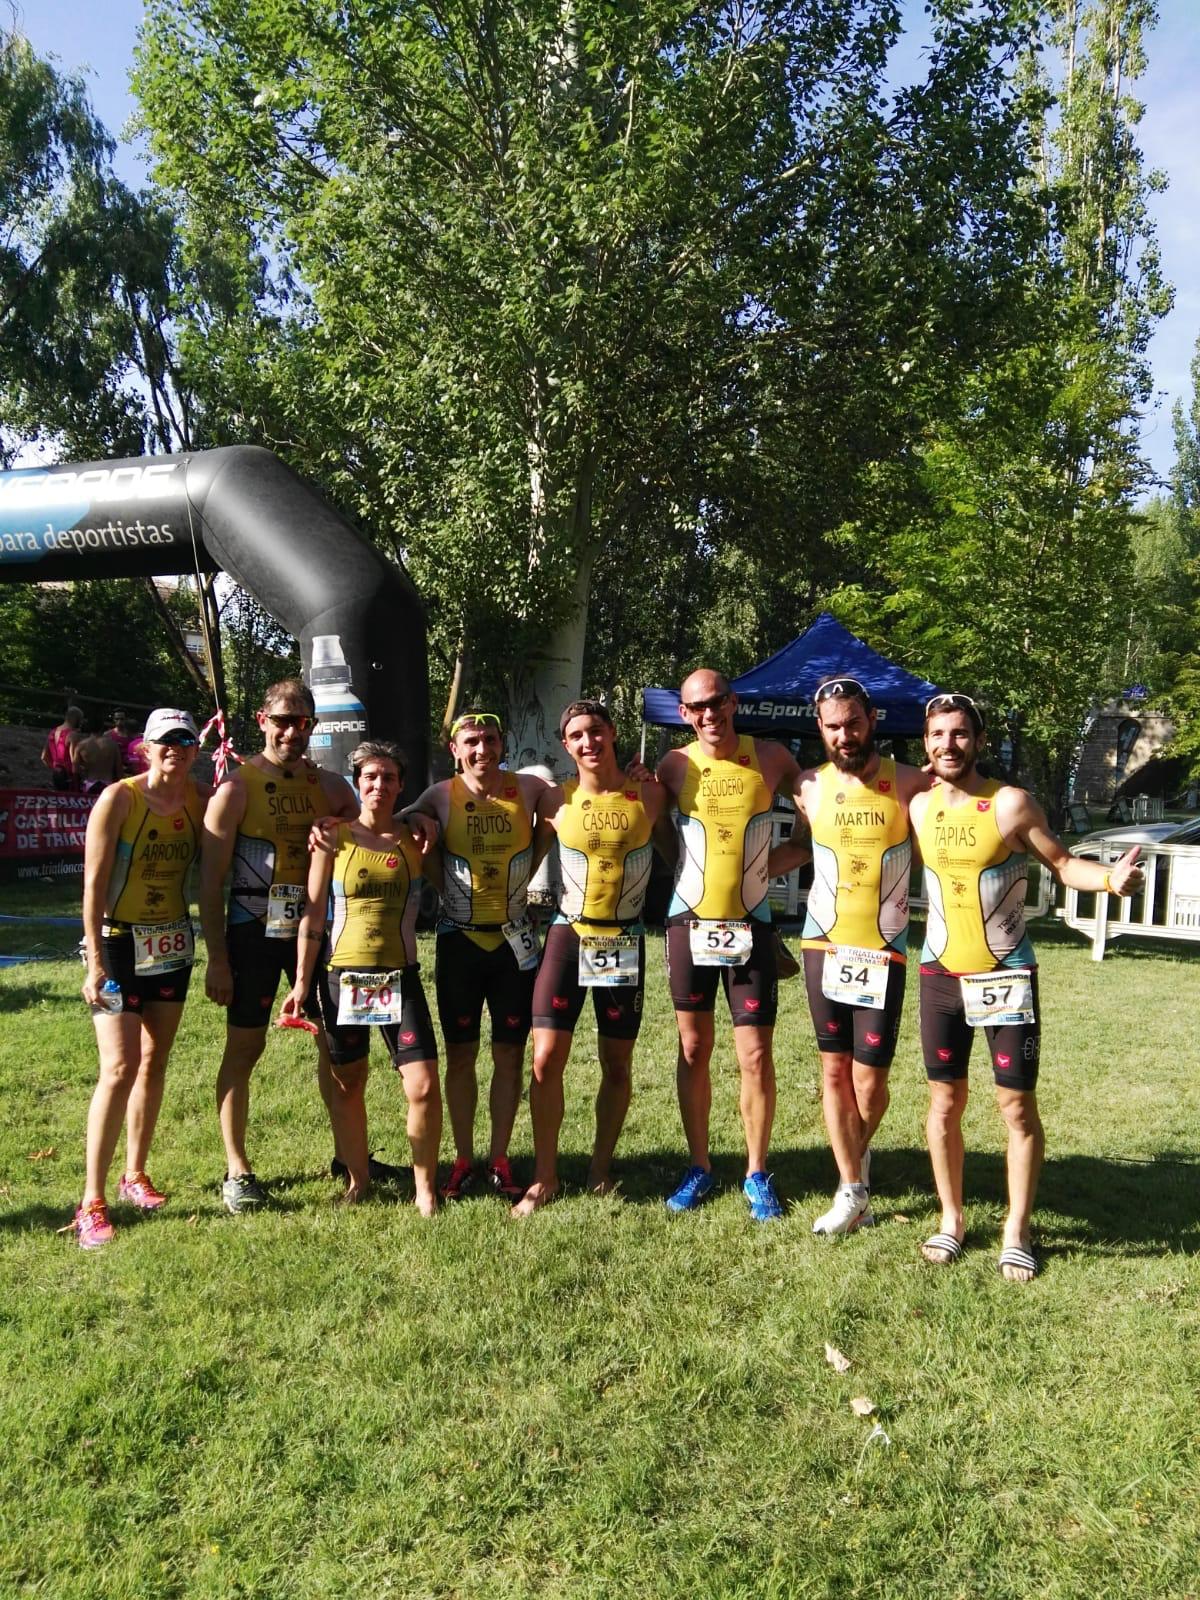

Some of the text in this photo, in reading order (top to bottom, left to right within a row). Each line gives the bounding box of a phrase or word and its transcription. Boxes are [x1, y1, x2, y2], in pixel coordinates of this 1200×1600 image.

[43, 519, 175, 555] deportistas
[702, 777, 744, 798] ESCUDERO
[268, 796, 316, 816] SICILIA
[15, 813, 88, 830] CASTILLA
[466, 812, 513, 836] FRUTOS
[582, 811, 629, 832] CASADO
[834, 807, 885, 826] MARTÍN
[16, 834, 39, 849] DE
[934, 826, 976, 847] TAPIAS
[139, 842, 190, 862] ARROYO
[143, 933, 186, 954] 168
[707, 931, 736, 948] 52
[595, 950, 620, 968] 51
[840, 964, 869, 986] 54
[351, 986, 392, 1006] 170
[982, 985, 1013, 1006] 57
